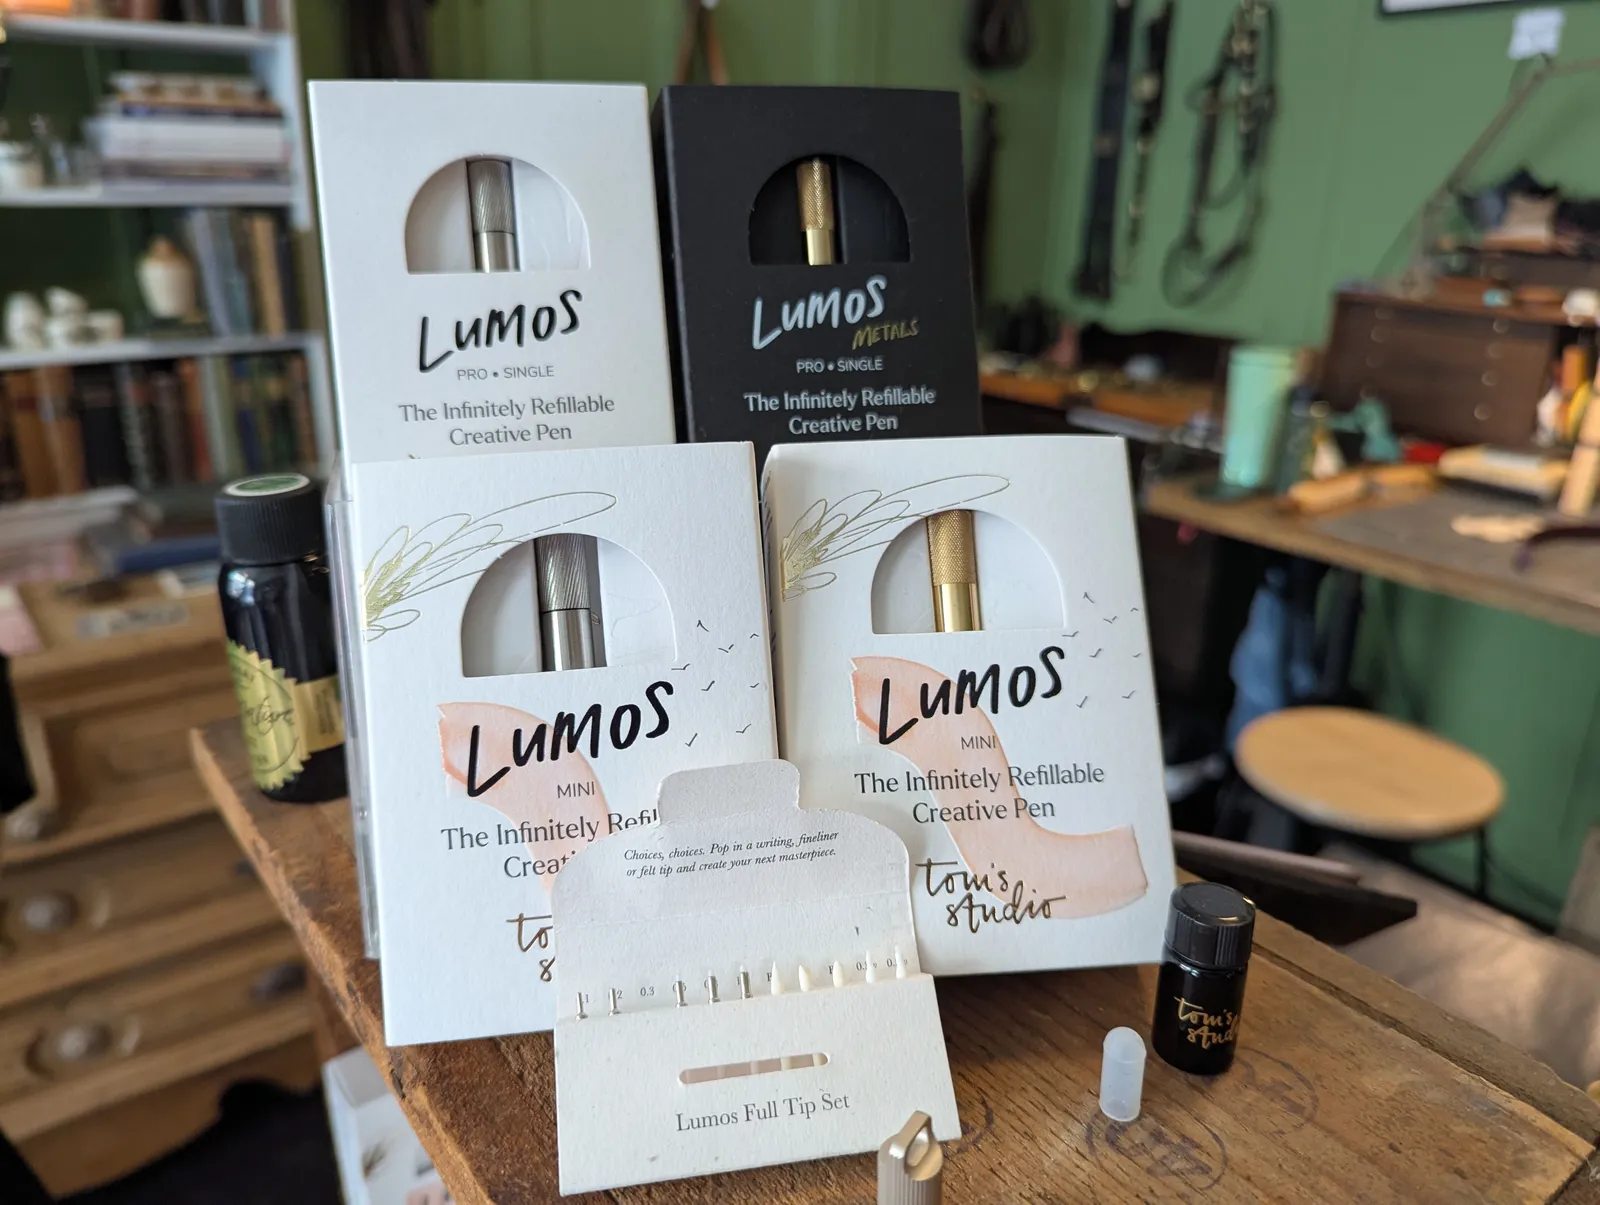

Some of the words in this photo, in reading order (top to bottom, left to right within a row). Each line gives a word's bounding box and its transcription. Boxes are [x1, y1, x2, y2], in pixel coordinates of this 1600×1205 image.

[852, 317, 919, 350] METALS
[457, 368, 488, 380] PRO
[503, 365, 555, 379] SINGLE
[796, 359, 825, 374] PRO
[837, 356, 884, 372] SINGLE
[399, 404, 438, 422] The
[443, 401, 526, 420] Infinitely
[532, 395, 615, 415] Refillable
[744, 393, 780, 412] The
[784, 388, 858, 411] Infinitely
[861, 384, 936, 406] Refillable
[450, 425, 531, 446] Creative
[536, 424, 572, 441] Pen
[788, 415, 862, 435] Creative
[865, 413, 899, 431] Pen
[961, 735, 996, 750] MINI
[557, 781, 595, 799] MINI
[854, 773, 899, 793] The
[906, 767, 1001, 793] Infinitely
[1008, 763, 1105, 786] Refillable
[912, 800, 1008, 823] Creative
[1014, 797, 1056, 818] Pen
[441, 827, 489, 850] The
[497, 816, 600, 845] Infinitely
[624, 849, 665, 861] Choices,
[668, 846, 706, 858] choices.
[710, 843, 730, 856] Pop
[732, 842, 743, 851] in
[746, 842, 753, 850] a
[756, 837, 795, 849] writing,
[796, 831, 839, 848] fineliner
[626, 868, 637, 876] or
[637, 865, 656, 879] felt
[659, 865, 673, 877] tip
[676, 862, 696, 873] and
[699, 860, 727, 871] create
[727, 857, 752, 871] your
[755, 855, 776, 865] next
[779, 848, 837, 862] masterpiece.
[915, 858, 1009, 897] tom's
[946, 880, 1066, 933] studio
[639, 986, 655, 997] 0.3
[676, 1113, 739, 1131] Lumos
[744, 1100, 779, 1122] Full
[783, 1097, 816, 1119] Tip
[821, 1093, 850, 1111] Set
